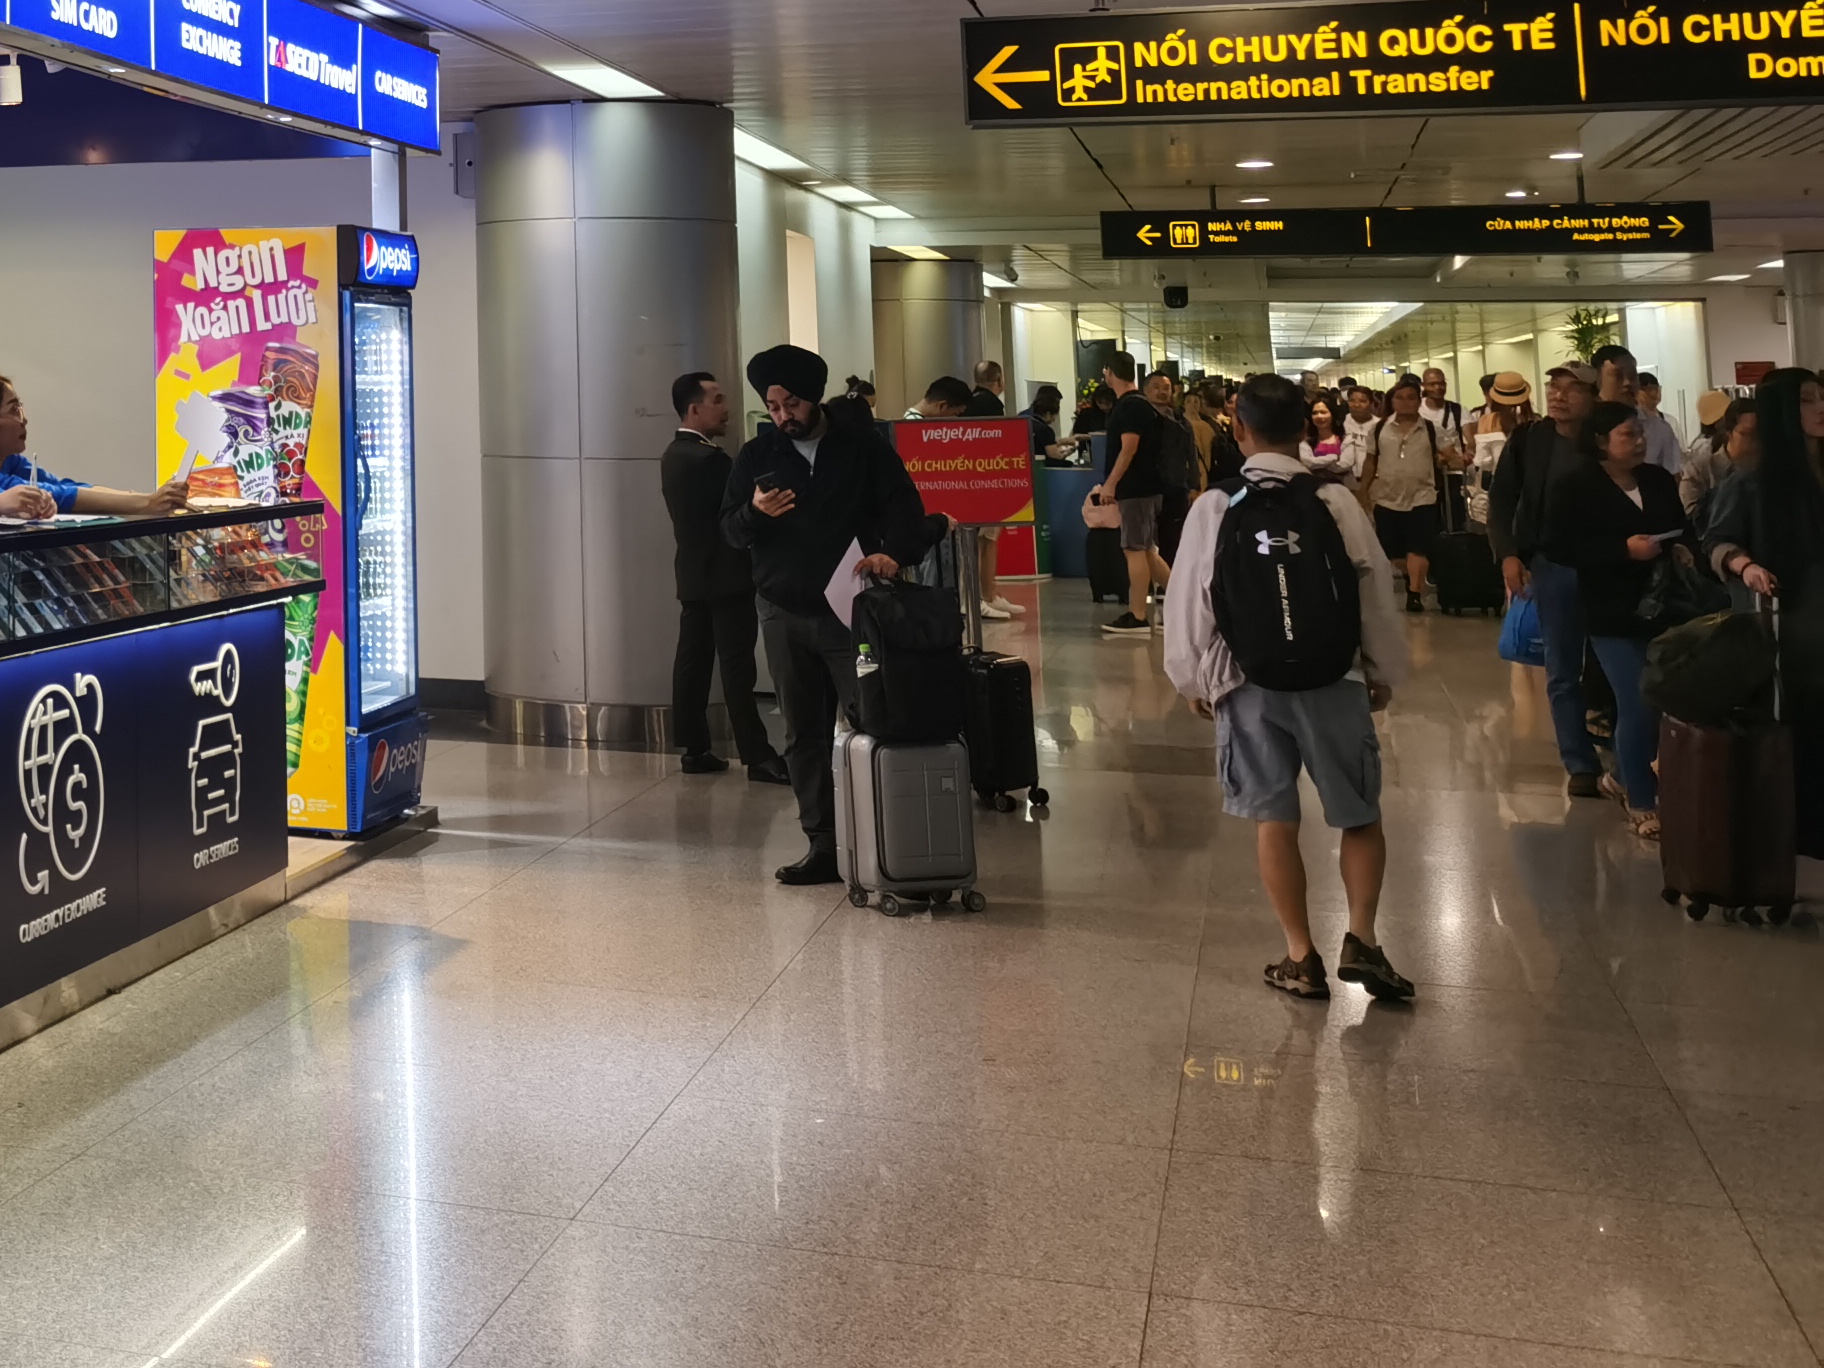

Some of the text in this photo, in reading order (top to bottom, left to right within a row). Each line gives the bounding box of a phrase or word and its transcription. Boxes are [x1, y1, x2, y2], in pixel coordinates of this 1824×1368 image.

[78, 2, 118, 39] CARD
[1599, 5, 1671, 46] NỐI
[181, 22, 241, 67] EXCHANGE
[1133, 12, 1556, 68] NỐI CHUYẾN QUỐC TẾ
[319, 53, 357, 94] Travel
[1136, 65, 1495, 103] International Transfer
[1747, 52, 1824, 79] Dom
[375, 70, 428, 109] CAR SERVICES
[1208, 220, 1283, 232] NHÀ VỆ SINH
[1208, 234, 1238, 243] Toilets
[1515, 218, 1551, 231] NHẬP
[1591, 218, 1610, 229] TỰ
[1612, 216, 1650, 229] ĐỘNG
[1572, 231, 1651, 241] Autogate System
[193, 238, 288, 292] Ngon
[379, 243, 412, 277] pepsi
[175, 280, 318, 343] Xoắn Lưỡi
[976, 453, 1009, 472] QUỐC
[1012, 452, 1027, 470] TẾ
[970, 478, 1029, 489] CONNECTIONS
[1277, 563, 1294, 641] UNDER ARMOUR
[193, 849, 210, 869] CAR
[19, 887, 107, 943] CURRENCY EXCHANGE
